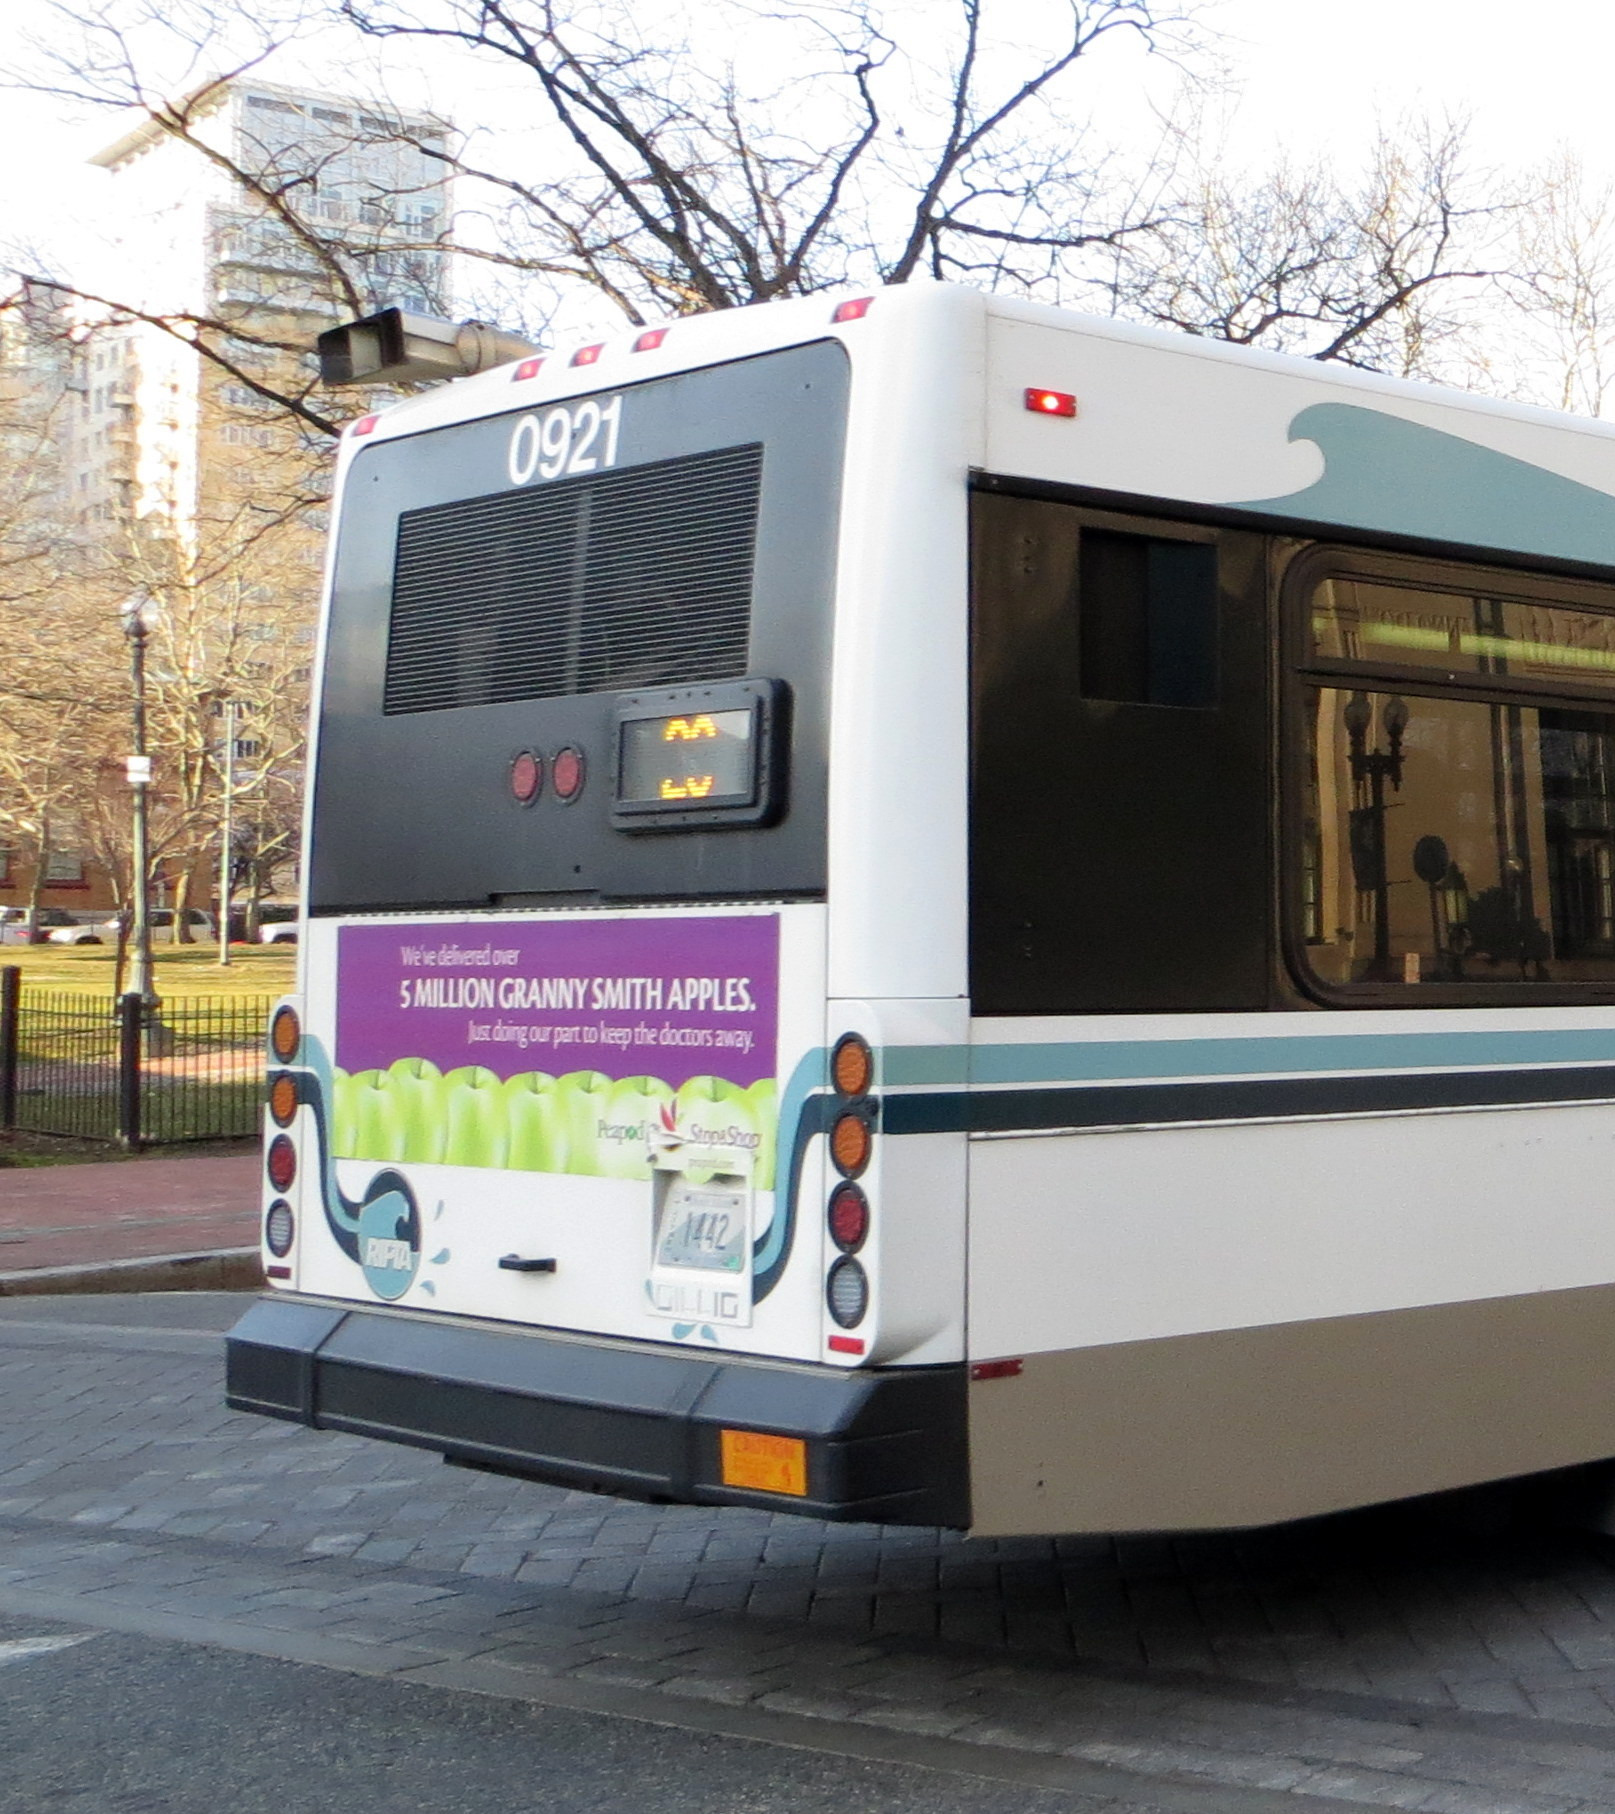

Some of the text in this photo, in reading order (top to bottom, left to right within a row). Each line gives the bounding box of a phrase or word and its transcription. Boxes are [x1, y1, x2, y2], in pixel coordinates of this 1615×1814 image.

[507, 394, 623, 487] 0921
[400, 943, 521, 966] We've delivered over
[400, 977, 756, 1012] 5 MILLION GRANNY SMITH APPLES.
[468, 1019, 755, 1054] Just doing our part to keep the doctors away.
[366, 1237, 411, 1271] RIPTA
[656, 1284, 738, 1319] GILLIG
